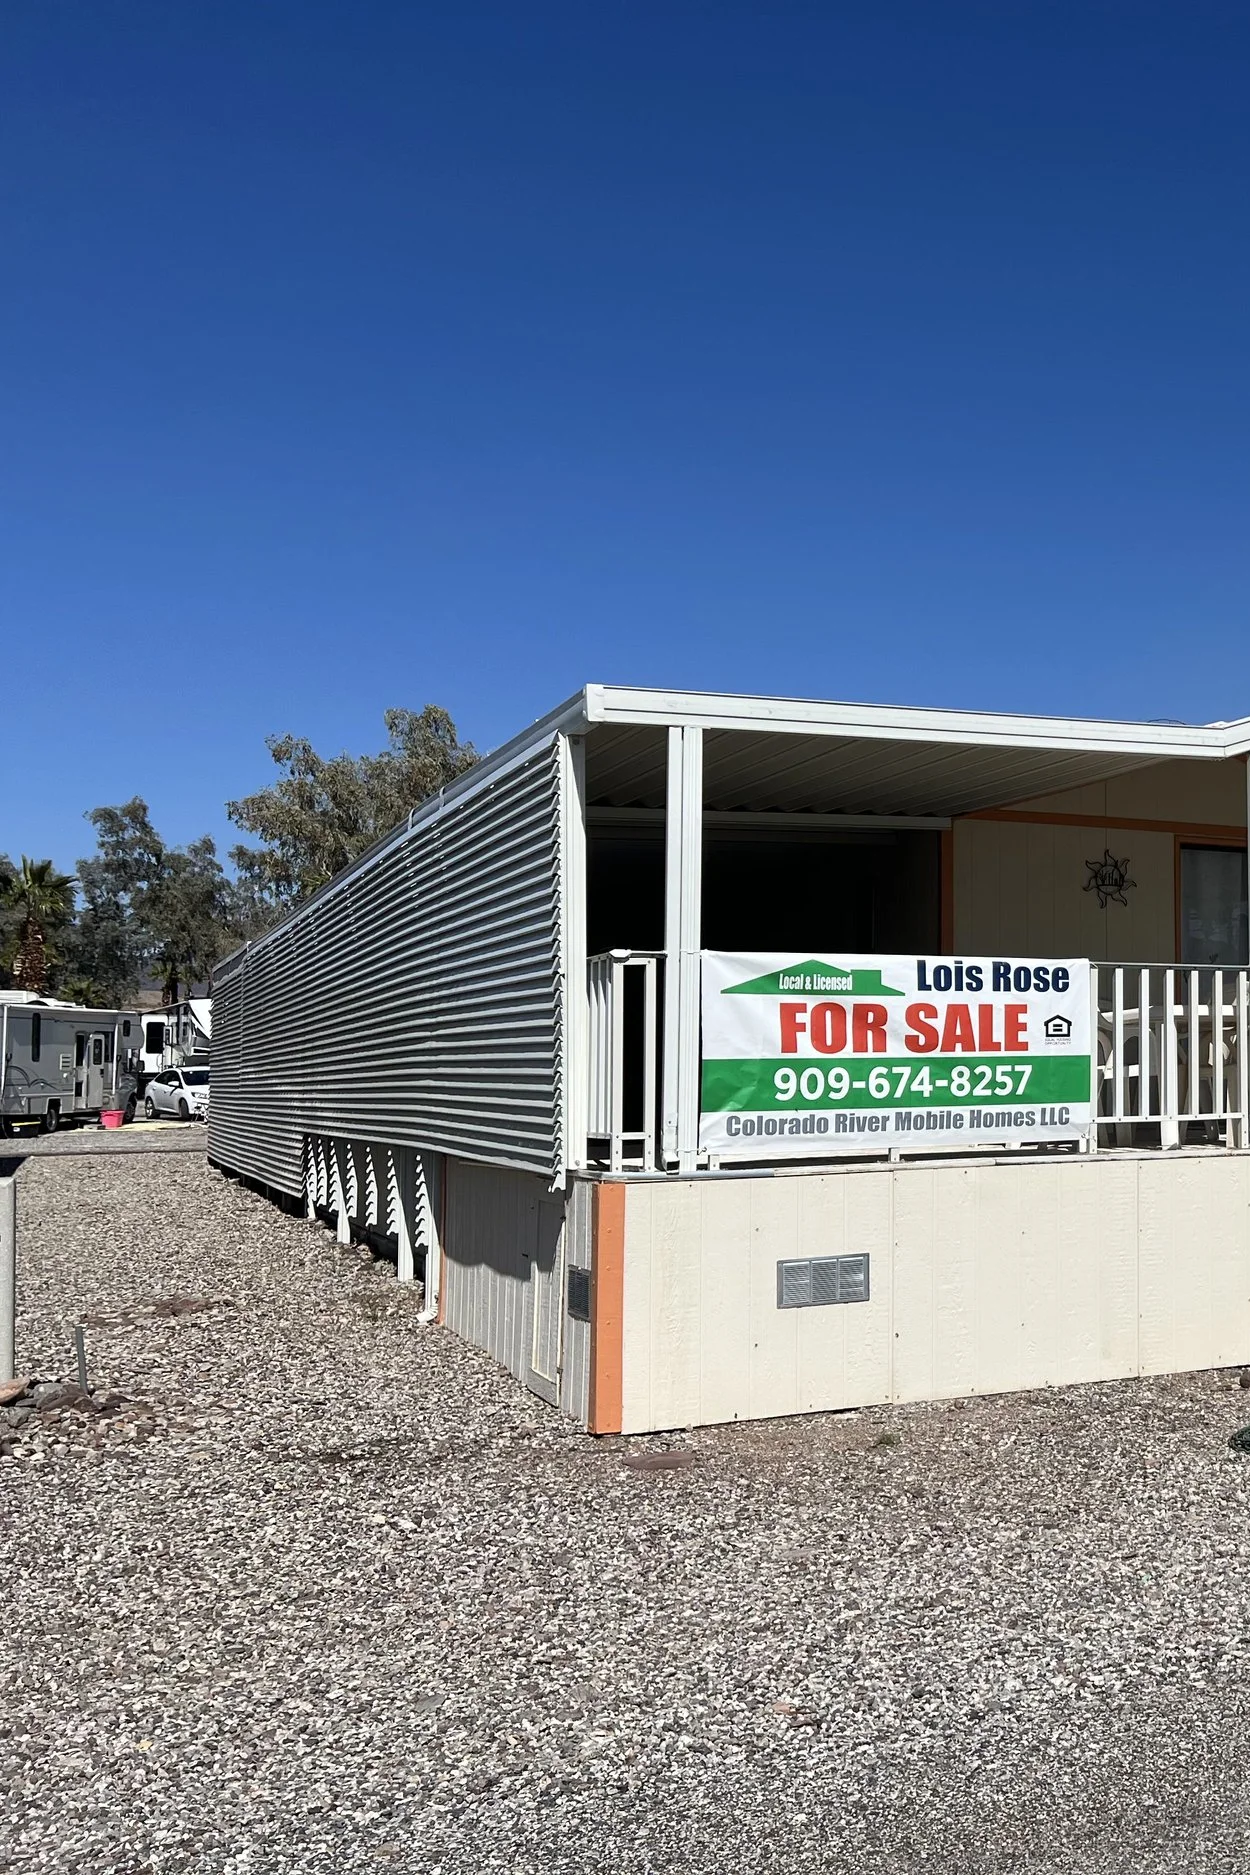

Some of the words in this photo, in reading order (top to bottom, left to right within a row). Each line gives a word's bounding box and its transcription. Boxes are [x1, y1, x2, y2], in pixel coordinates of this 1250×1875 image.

[779, 974, 803, 990] Local
[805, 974, 812, 989] &
[813, 973, 853, 991] Licensed
[917, 960, 983, 992] Lois
[992, 961, 1069, 992] Rose
[780, 1002, 888, 1053] FOR
[905, 1003, 1028, 1053] SALE
[774, 1064, 1033, 1101] 909-674-8257
[726, 1113, 828, 1136] Colorado
[835, 1112, 890, 1134] River
[895, 1110, 964, 1131] Mobile
[970, 1108, 1036, 1129] Homes
[1040, 1106, 1070, 1127] LLC
